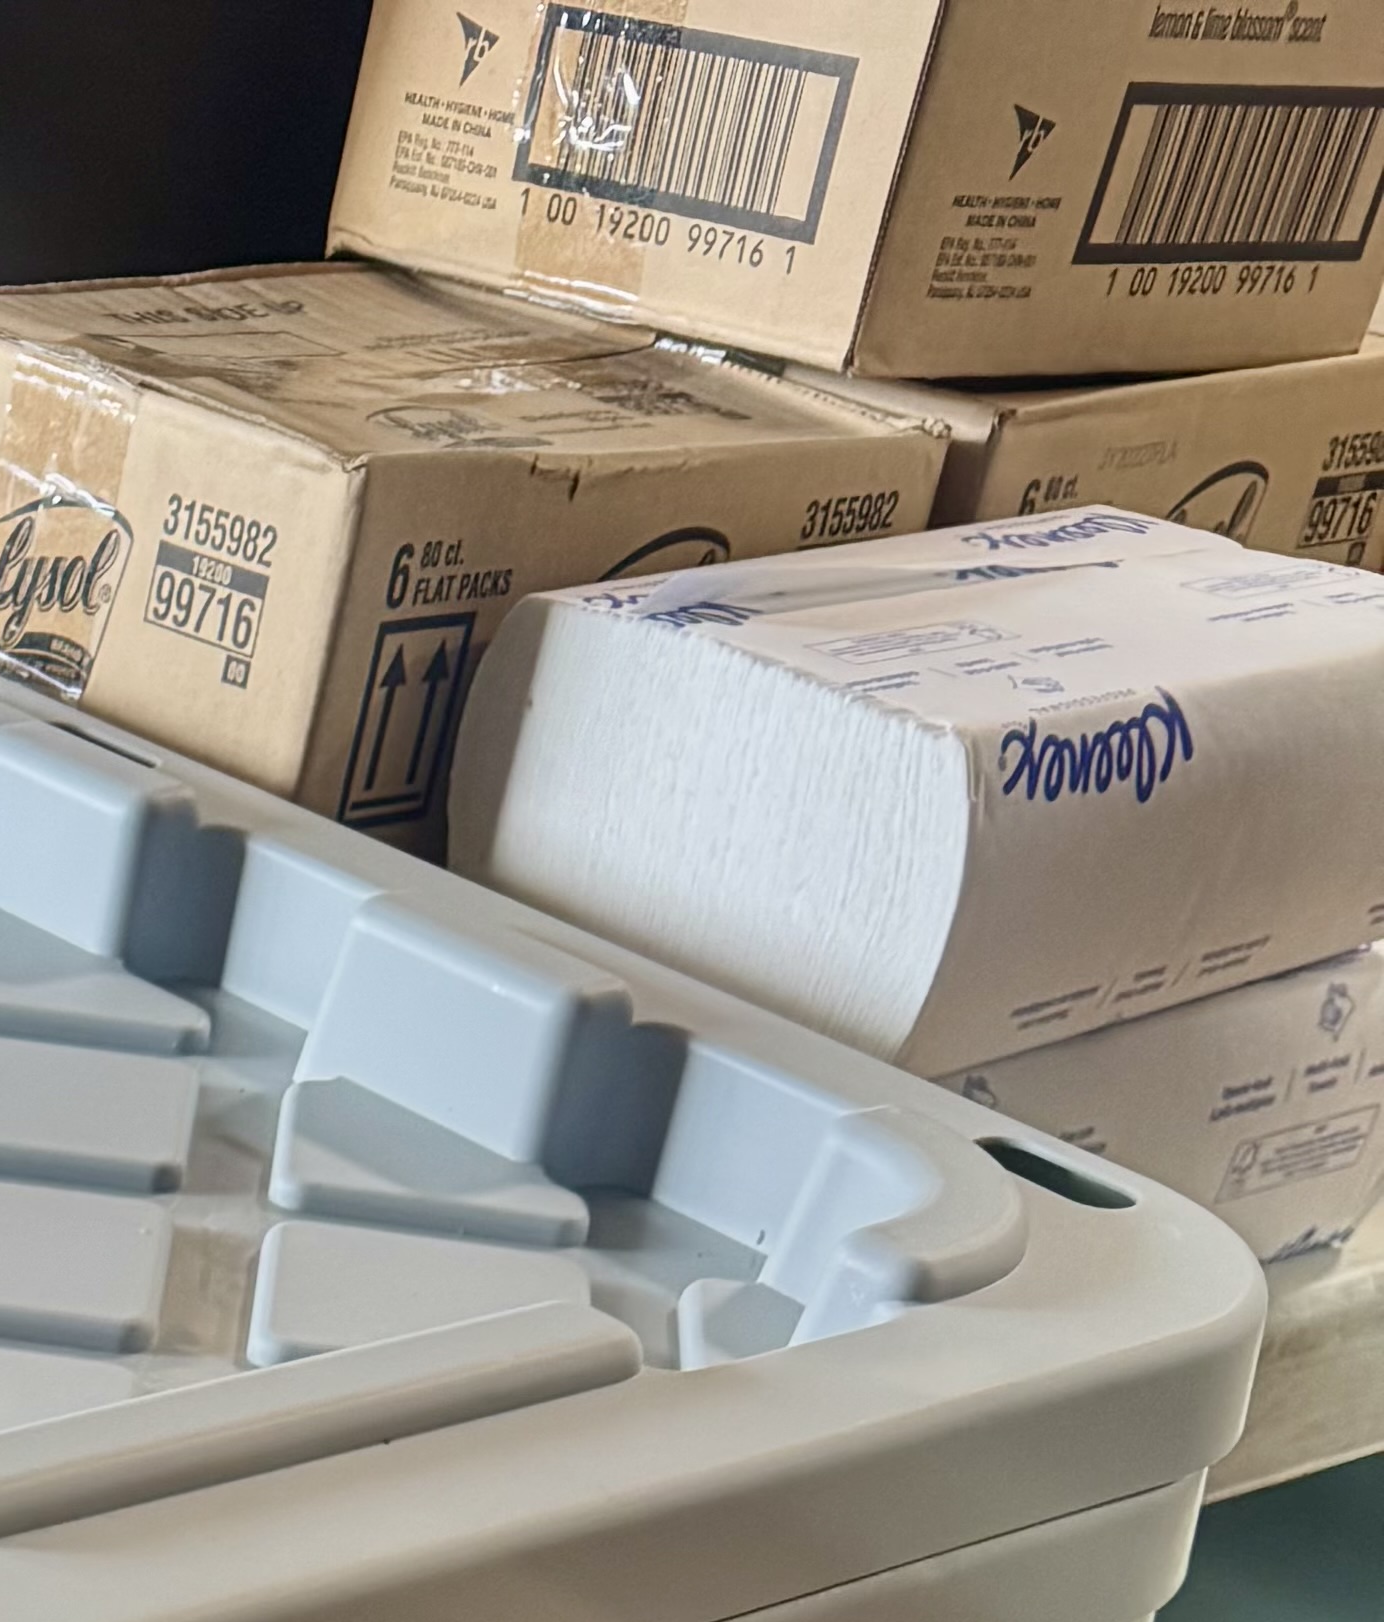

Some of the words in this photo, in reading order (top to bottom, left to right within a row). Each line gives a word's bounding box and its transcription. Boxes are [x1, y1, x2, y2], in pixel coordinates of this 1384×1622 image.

[520, 187, 531, 217] 1
[546, 193, 578, 227] 00
[596, 205, 670, 247] 19200
[688, 223, 764, 269] 99716
[784, 246, 797, 276] 1
[1105, 267, 1119, 297] 1
[1128, 267, 1156, 297] 00
[1166, 266, 1228, 297] 19200
[1235, 265, 1297, 295] 99716
[1308, 265, 1319, 294] 1
[162, 492, 279, 569] 3155982
[800, 489, 900, 540] 3155982
[1303, 492, 1378, 543] 99716
[190, 555, 233, 586] 19200
[386, 543, 415, 609] 6
[421, 540, 444, 571] 80
[151, 569, 256, 650] 99716
[412, 575, 458, 607] FLAT
[457, 568, 513, 600] PACKS
[1000, 685, 1194, 803] Kleenex
